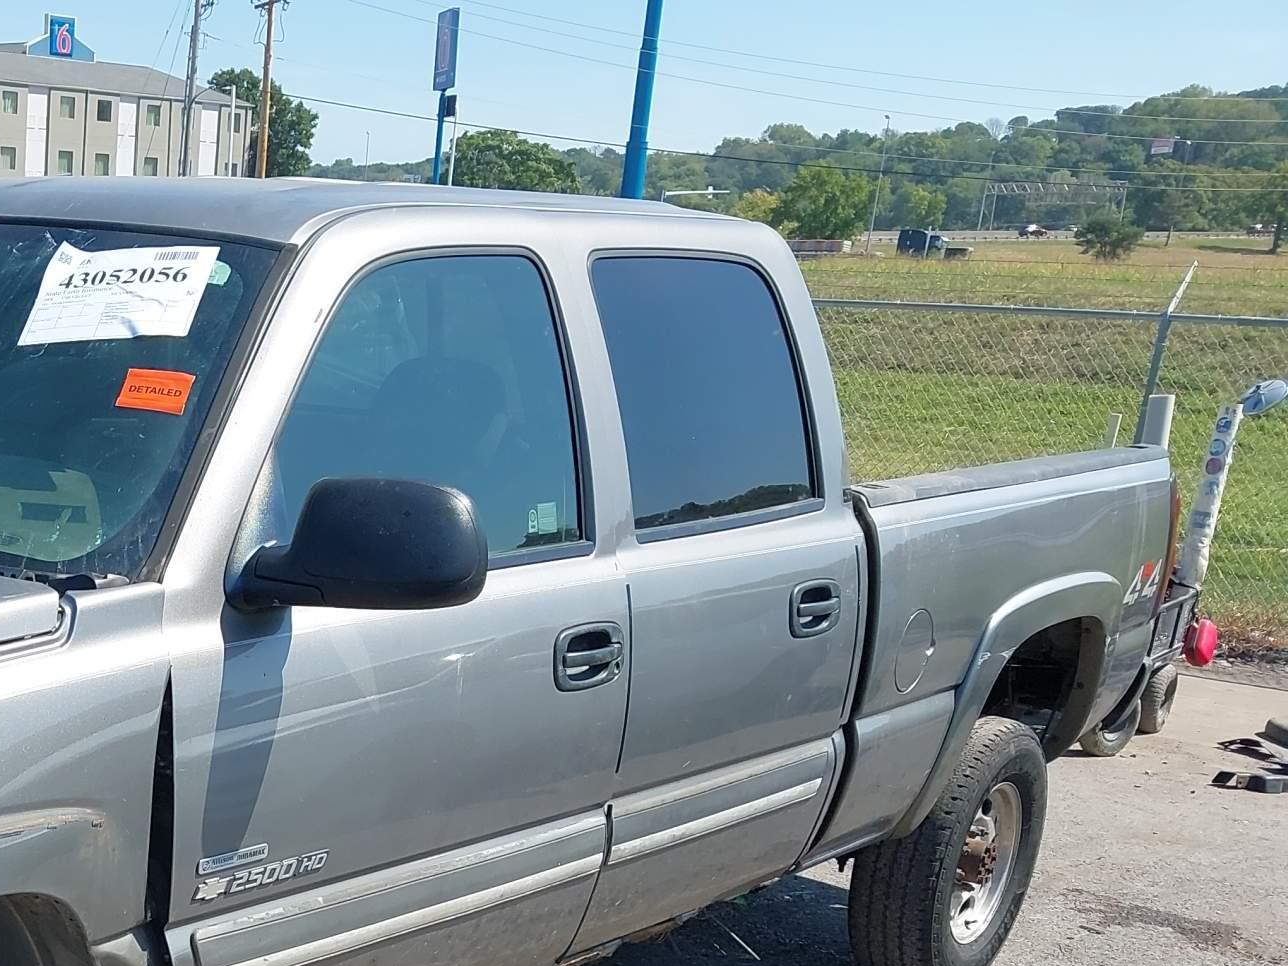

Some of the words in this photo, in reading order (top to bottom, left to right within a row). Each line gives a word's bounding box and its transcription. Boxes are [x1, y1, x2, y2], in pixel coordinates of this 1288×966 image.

[56, 23, 72, 55] 6
[59, 266, 191, 289] 43052056
[128, 384, 183, 398] DETAILED
[229, 858, 298, 893] 2500
[299, 851, 329, 873] HD
